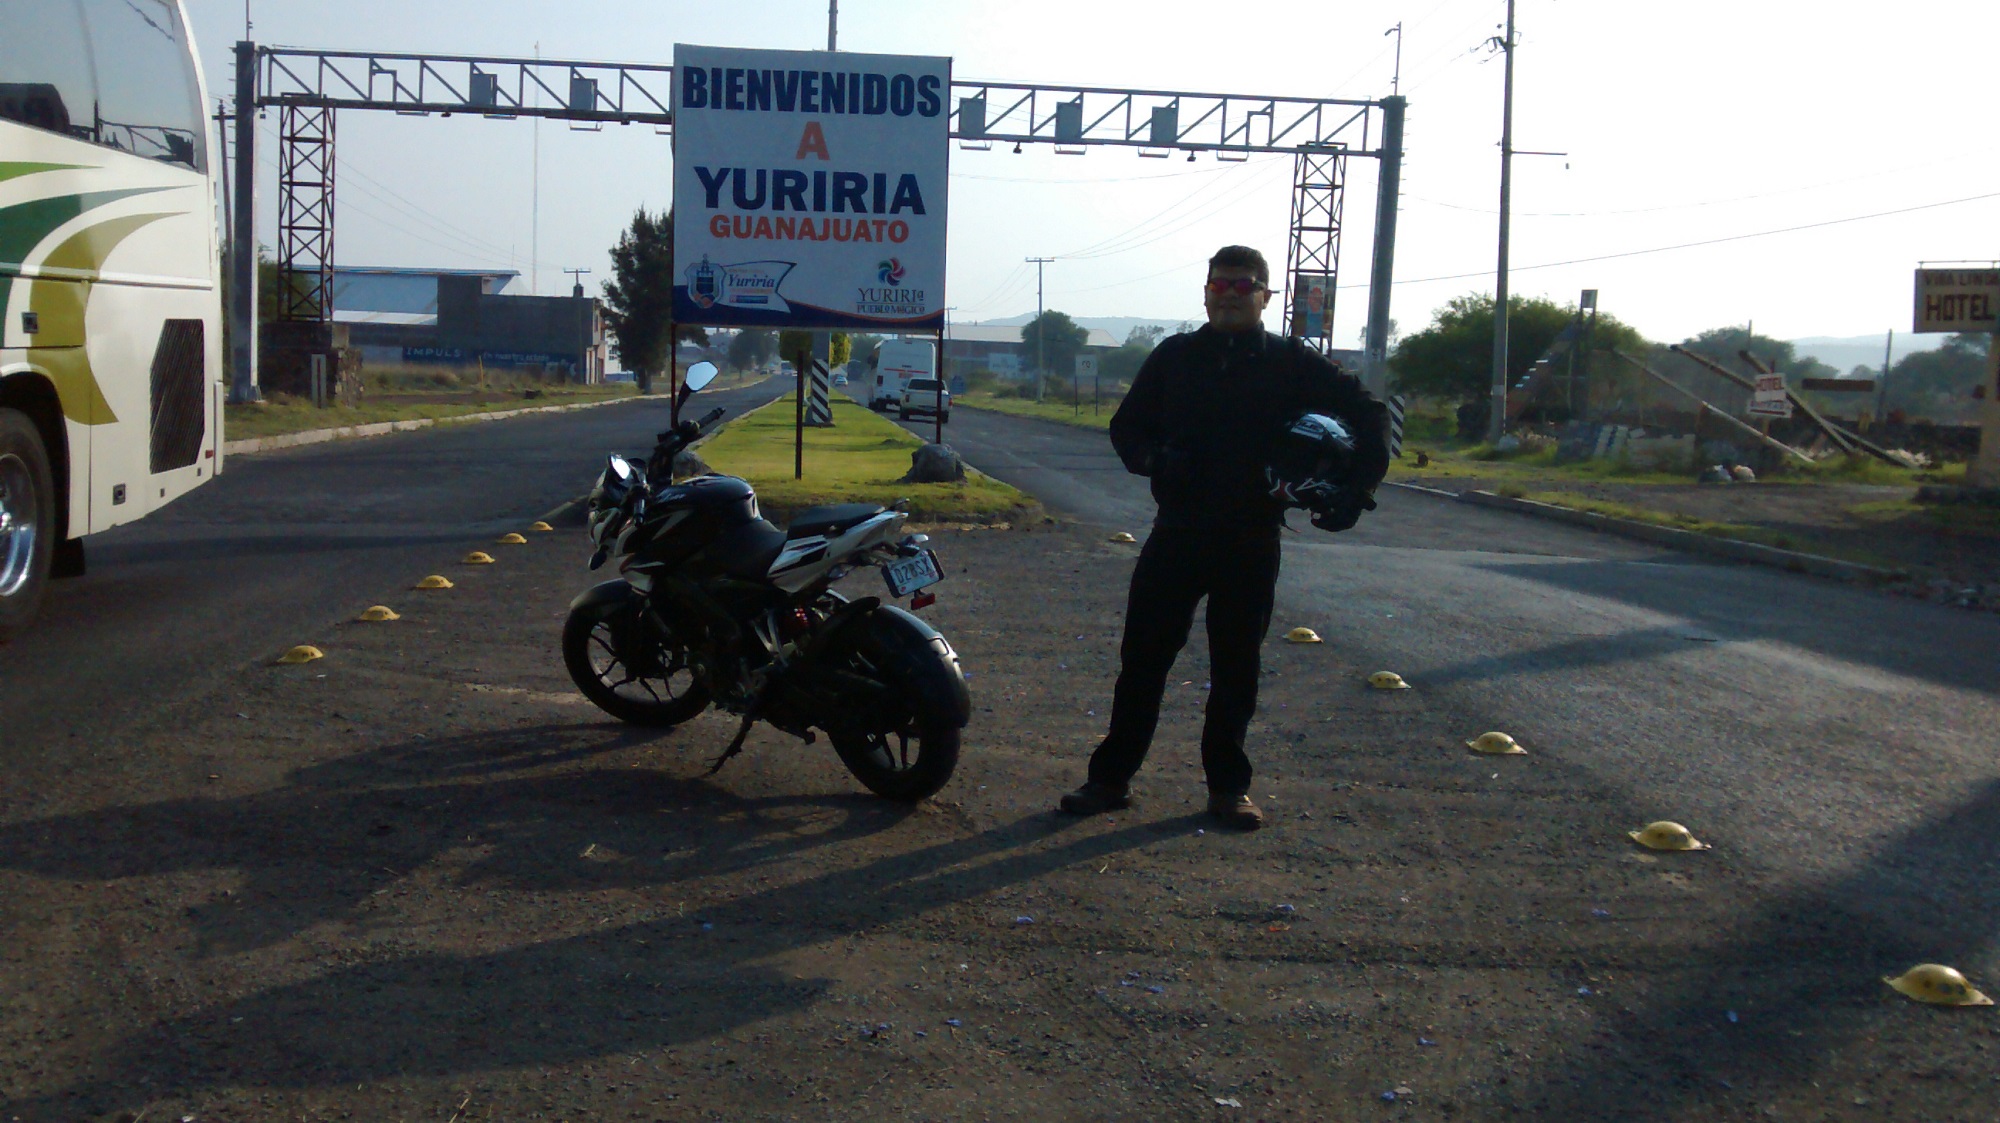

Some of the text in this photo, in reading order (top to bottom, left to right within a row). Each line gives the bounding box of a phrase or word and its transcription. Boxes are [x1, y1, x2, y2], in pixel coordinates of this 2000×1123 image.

[682, 65, 941, 117] BIENVENIDOS
[795, 121, 830, 161] A
[694, 166, 926, 215] YURIRIA
[709, 214, 909, 244] GUANAJUATO
[728, 274, 775, 288] Yuriria
[1926, 294, 1996, 321] HOTEL
